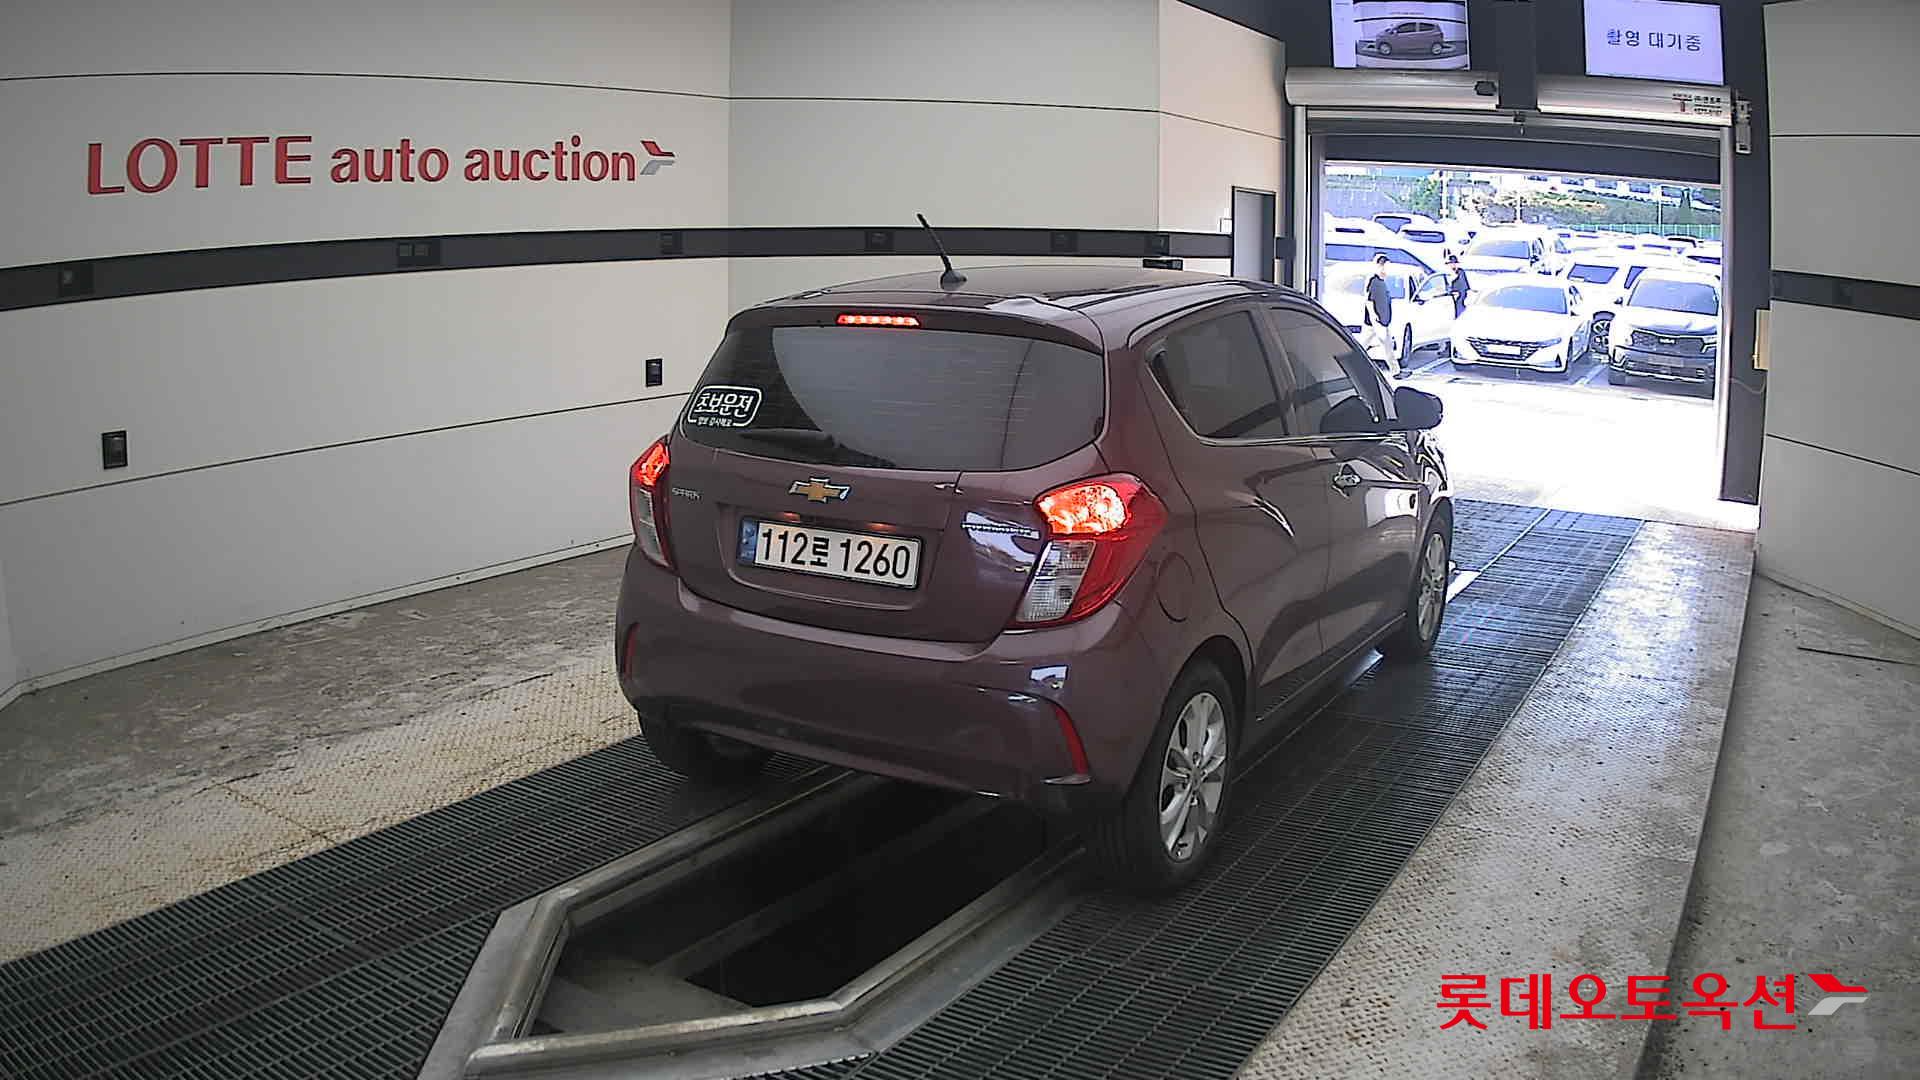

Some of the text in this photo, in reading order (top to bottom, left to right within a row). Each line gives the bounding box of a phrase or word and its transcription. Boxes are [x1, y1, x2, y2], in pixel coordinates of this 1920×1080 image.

[1648, 31, 1701, 52] 대기중
[87, 135, 638, 194] LOTTE auto auction
[693, 392, 754, 418] 초보운전
[762, 526, 911, 579] 112로 1260
